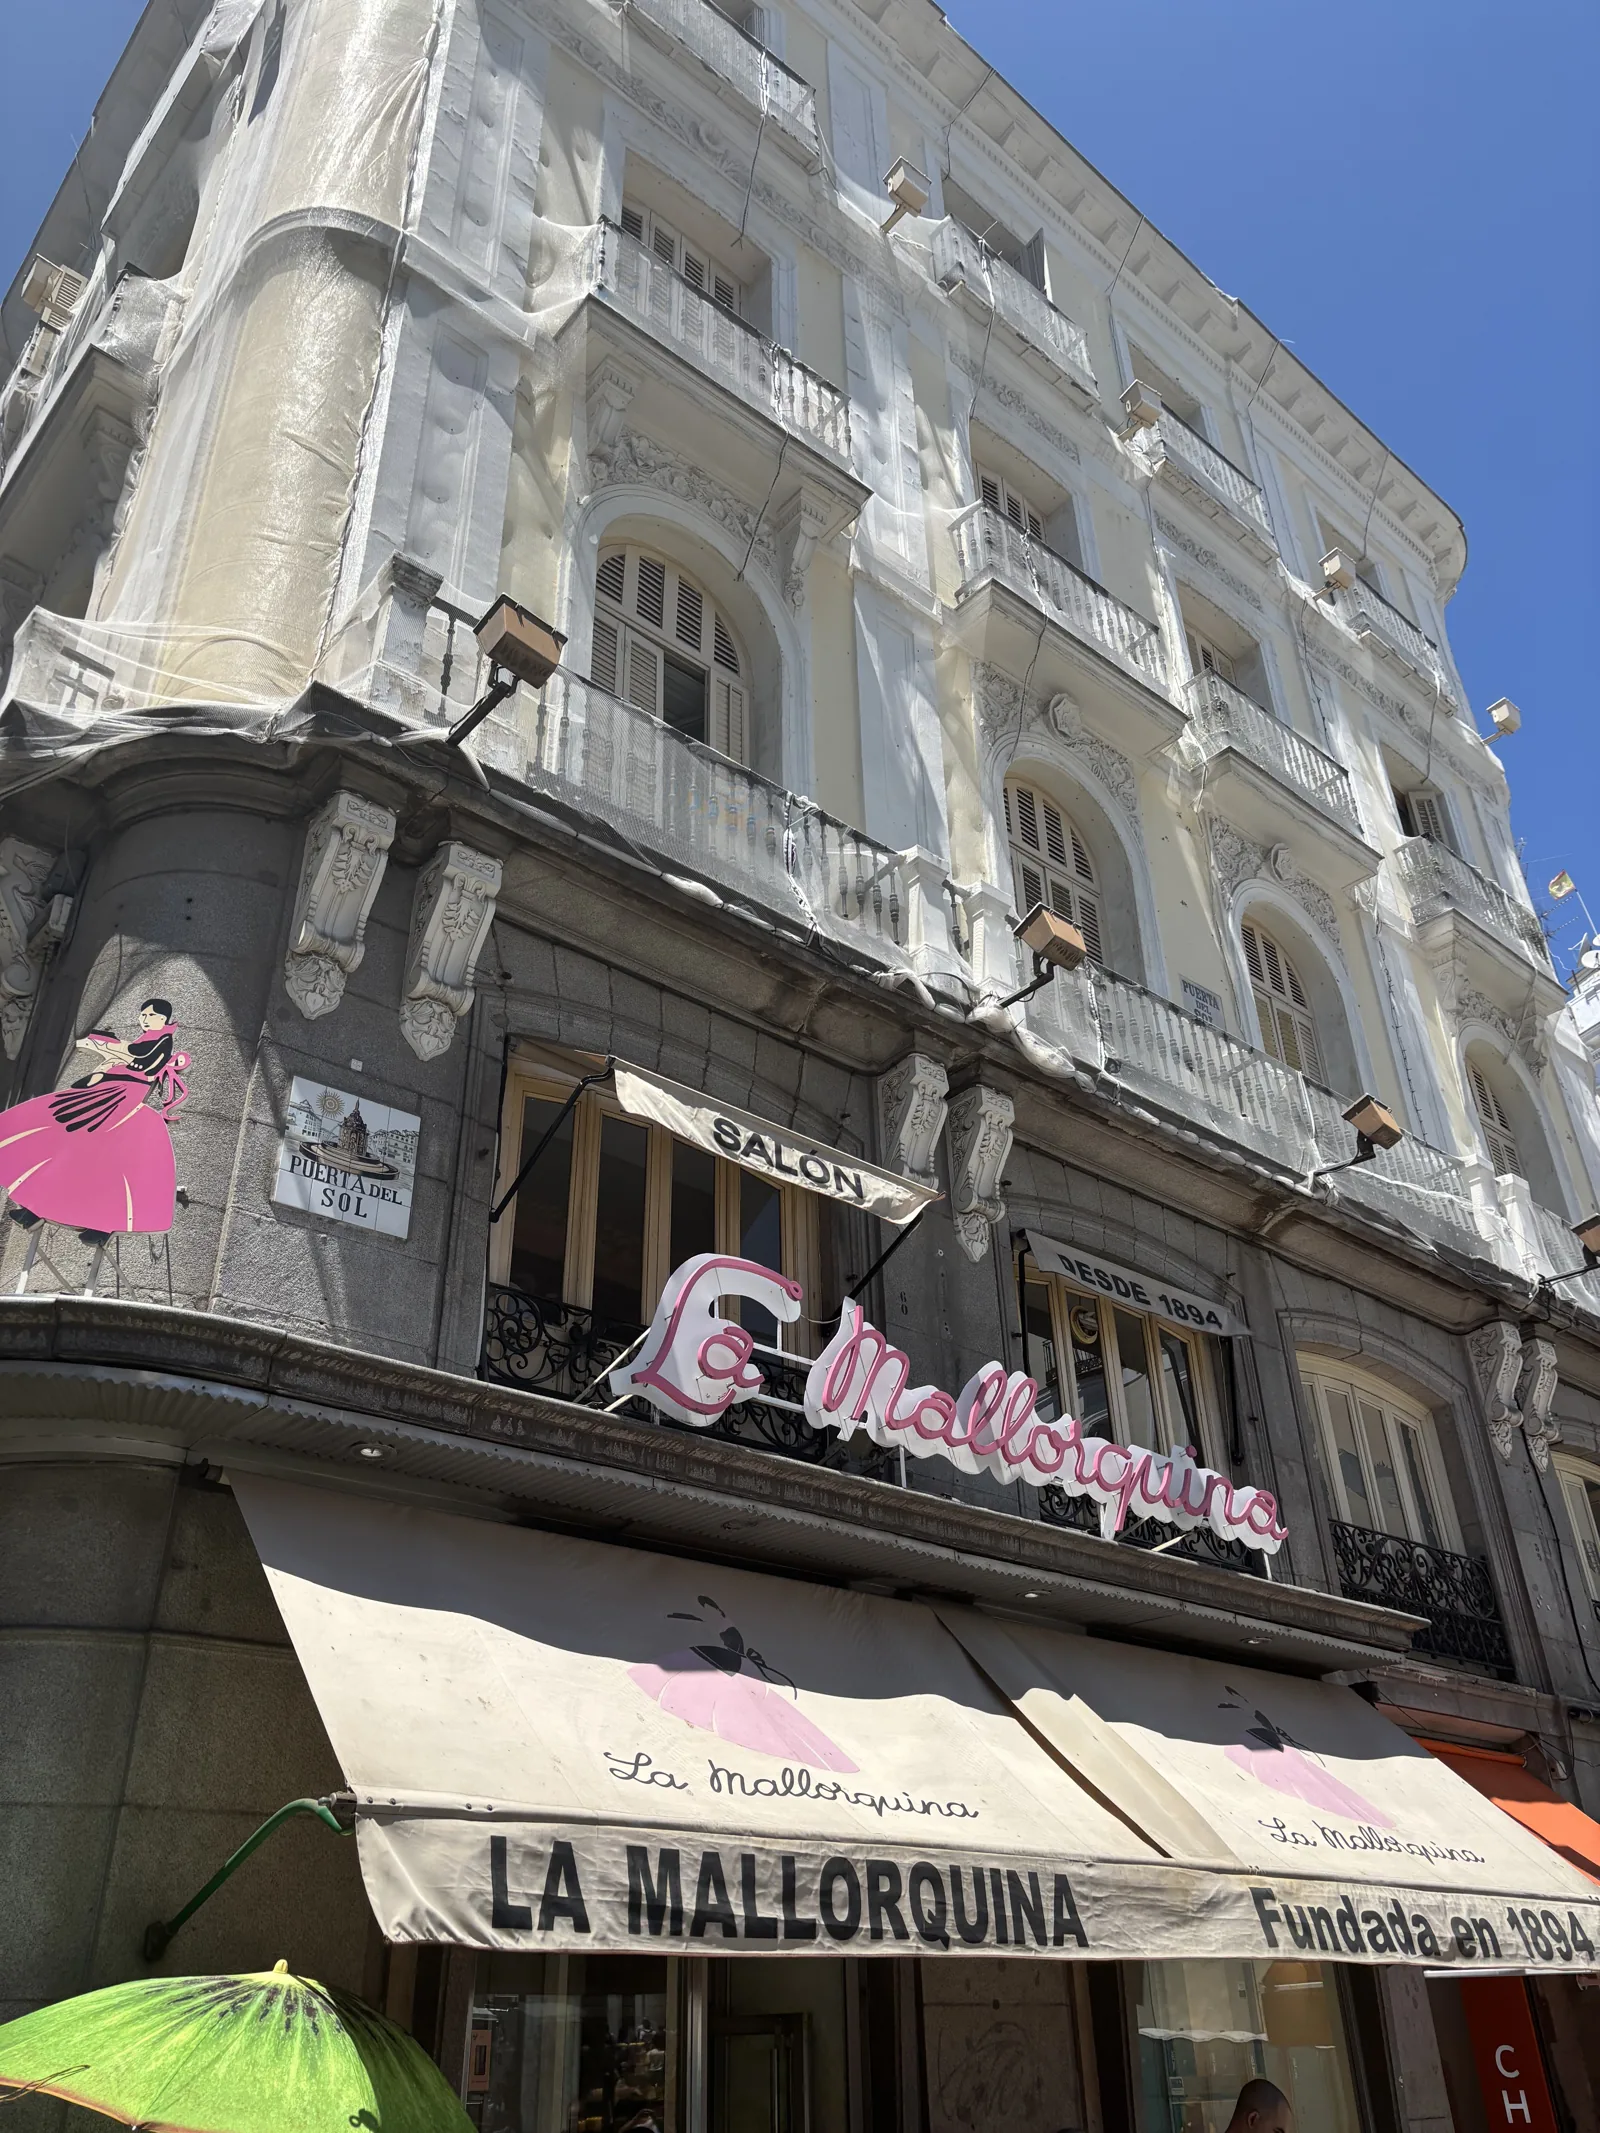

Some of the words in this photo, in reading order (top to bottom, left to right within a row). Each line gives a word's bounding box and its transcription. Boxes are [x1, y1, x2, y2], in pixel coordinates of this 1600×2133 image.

[1182, 980, 1220, 1010] PUERTA
[1196, 1000, 1211, 1015] DEL
[289, 1155, 366, 1195] PUERTA
[368, 1183, 403, 1205] DEL
[713, 1117, 864, 1199] SALÓN
[321, 1188, 367, 1218] SOL
[1056, 1253, 1151, 1305] DESDE
[1158, 1293, 1223, 1329] 1894
[630, 1257, 804, 1417] La
[821, 1304, 1288, 1541] Mallorquina
[603, 1751, 688, 1790] La
[708, 1759, 980, 1819] Mallorquina
[1258, 1817, 1317, 1847] La
[1312, 1819, 1485, 1866] Mallorquina
[490, 1835, 591, 1934] LA
[627, 1845, 1090, 1951] MALLORQUINA
[1249, 1886, 1441, 1957] Fundada
[1450, 1916, 1502, 1959] en
[1506, 1906, 1596, 1962] 1894
